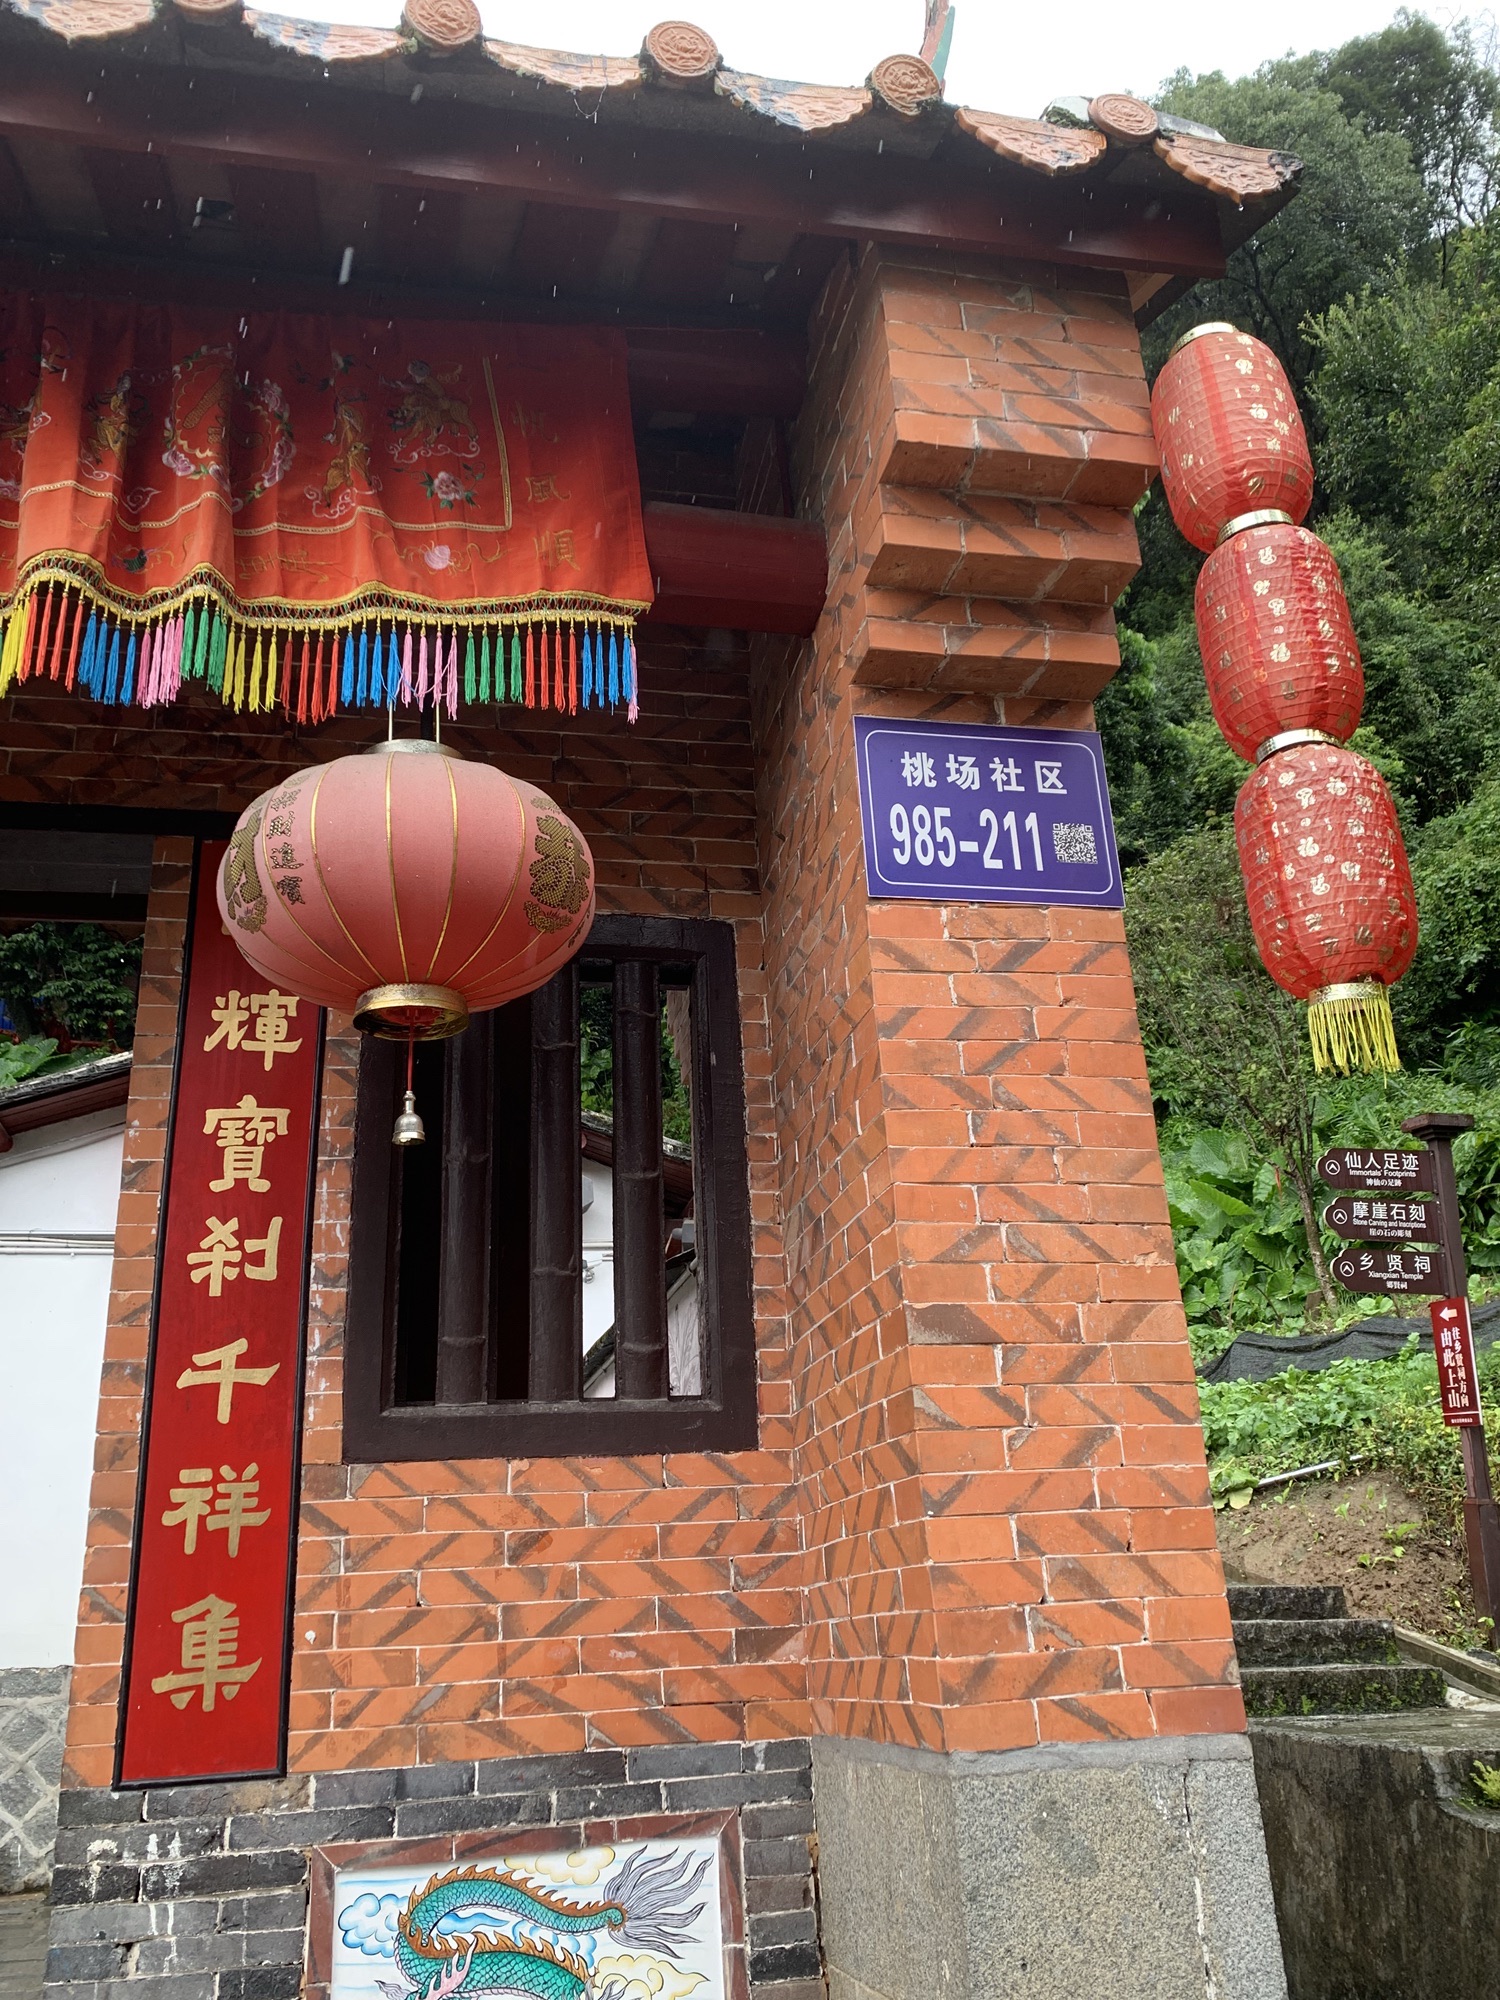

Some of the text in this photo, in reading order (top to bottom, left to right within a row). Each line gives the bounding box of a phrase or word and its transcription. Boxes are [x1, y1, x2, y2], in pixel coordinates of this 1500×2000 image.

[900, 751, 1068, 795] 桃场社区
[889, 803, 1044, 871] 985-211
[1344, 1151, 1420, 1171] 仙人足迹
[1384, 1170, 1416, 1178] Footprints
[1353, 1201, 1426, 1222] 摩崖石刻
[1353, 1218, 1368, 1226] Stone
[1368, 1219, 1388, 1228] Carving
[1399, 1221, 1427, 1230] Inscriptions
[1360, 1253, 1431, 1273] 乡贤祠
[1368, 1271, 1424, 1280] Xiangxian Temple
[151, 915, 303, 1712] 輝寶刹千祥集
[1441, 1328, 1461, 1408] 由此上山
